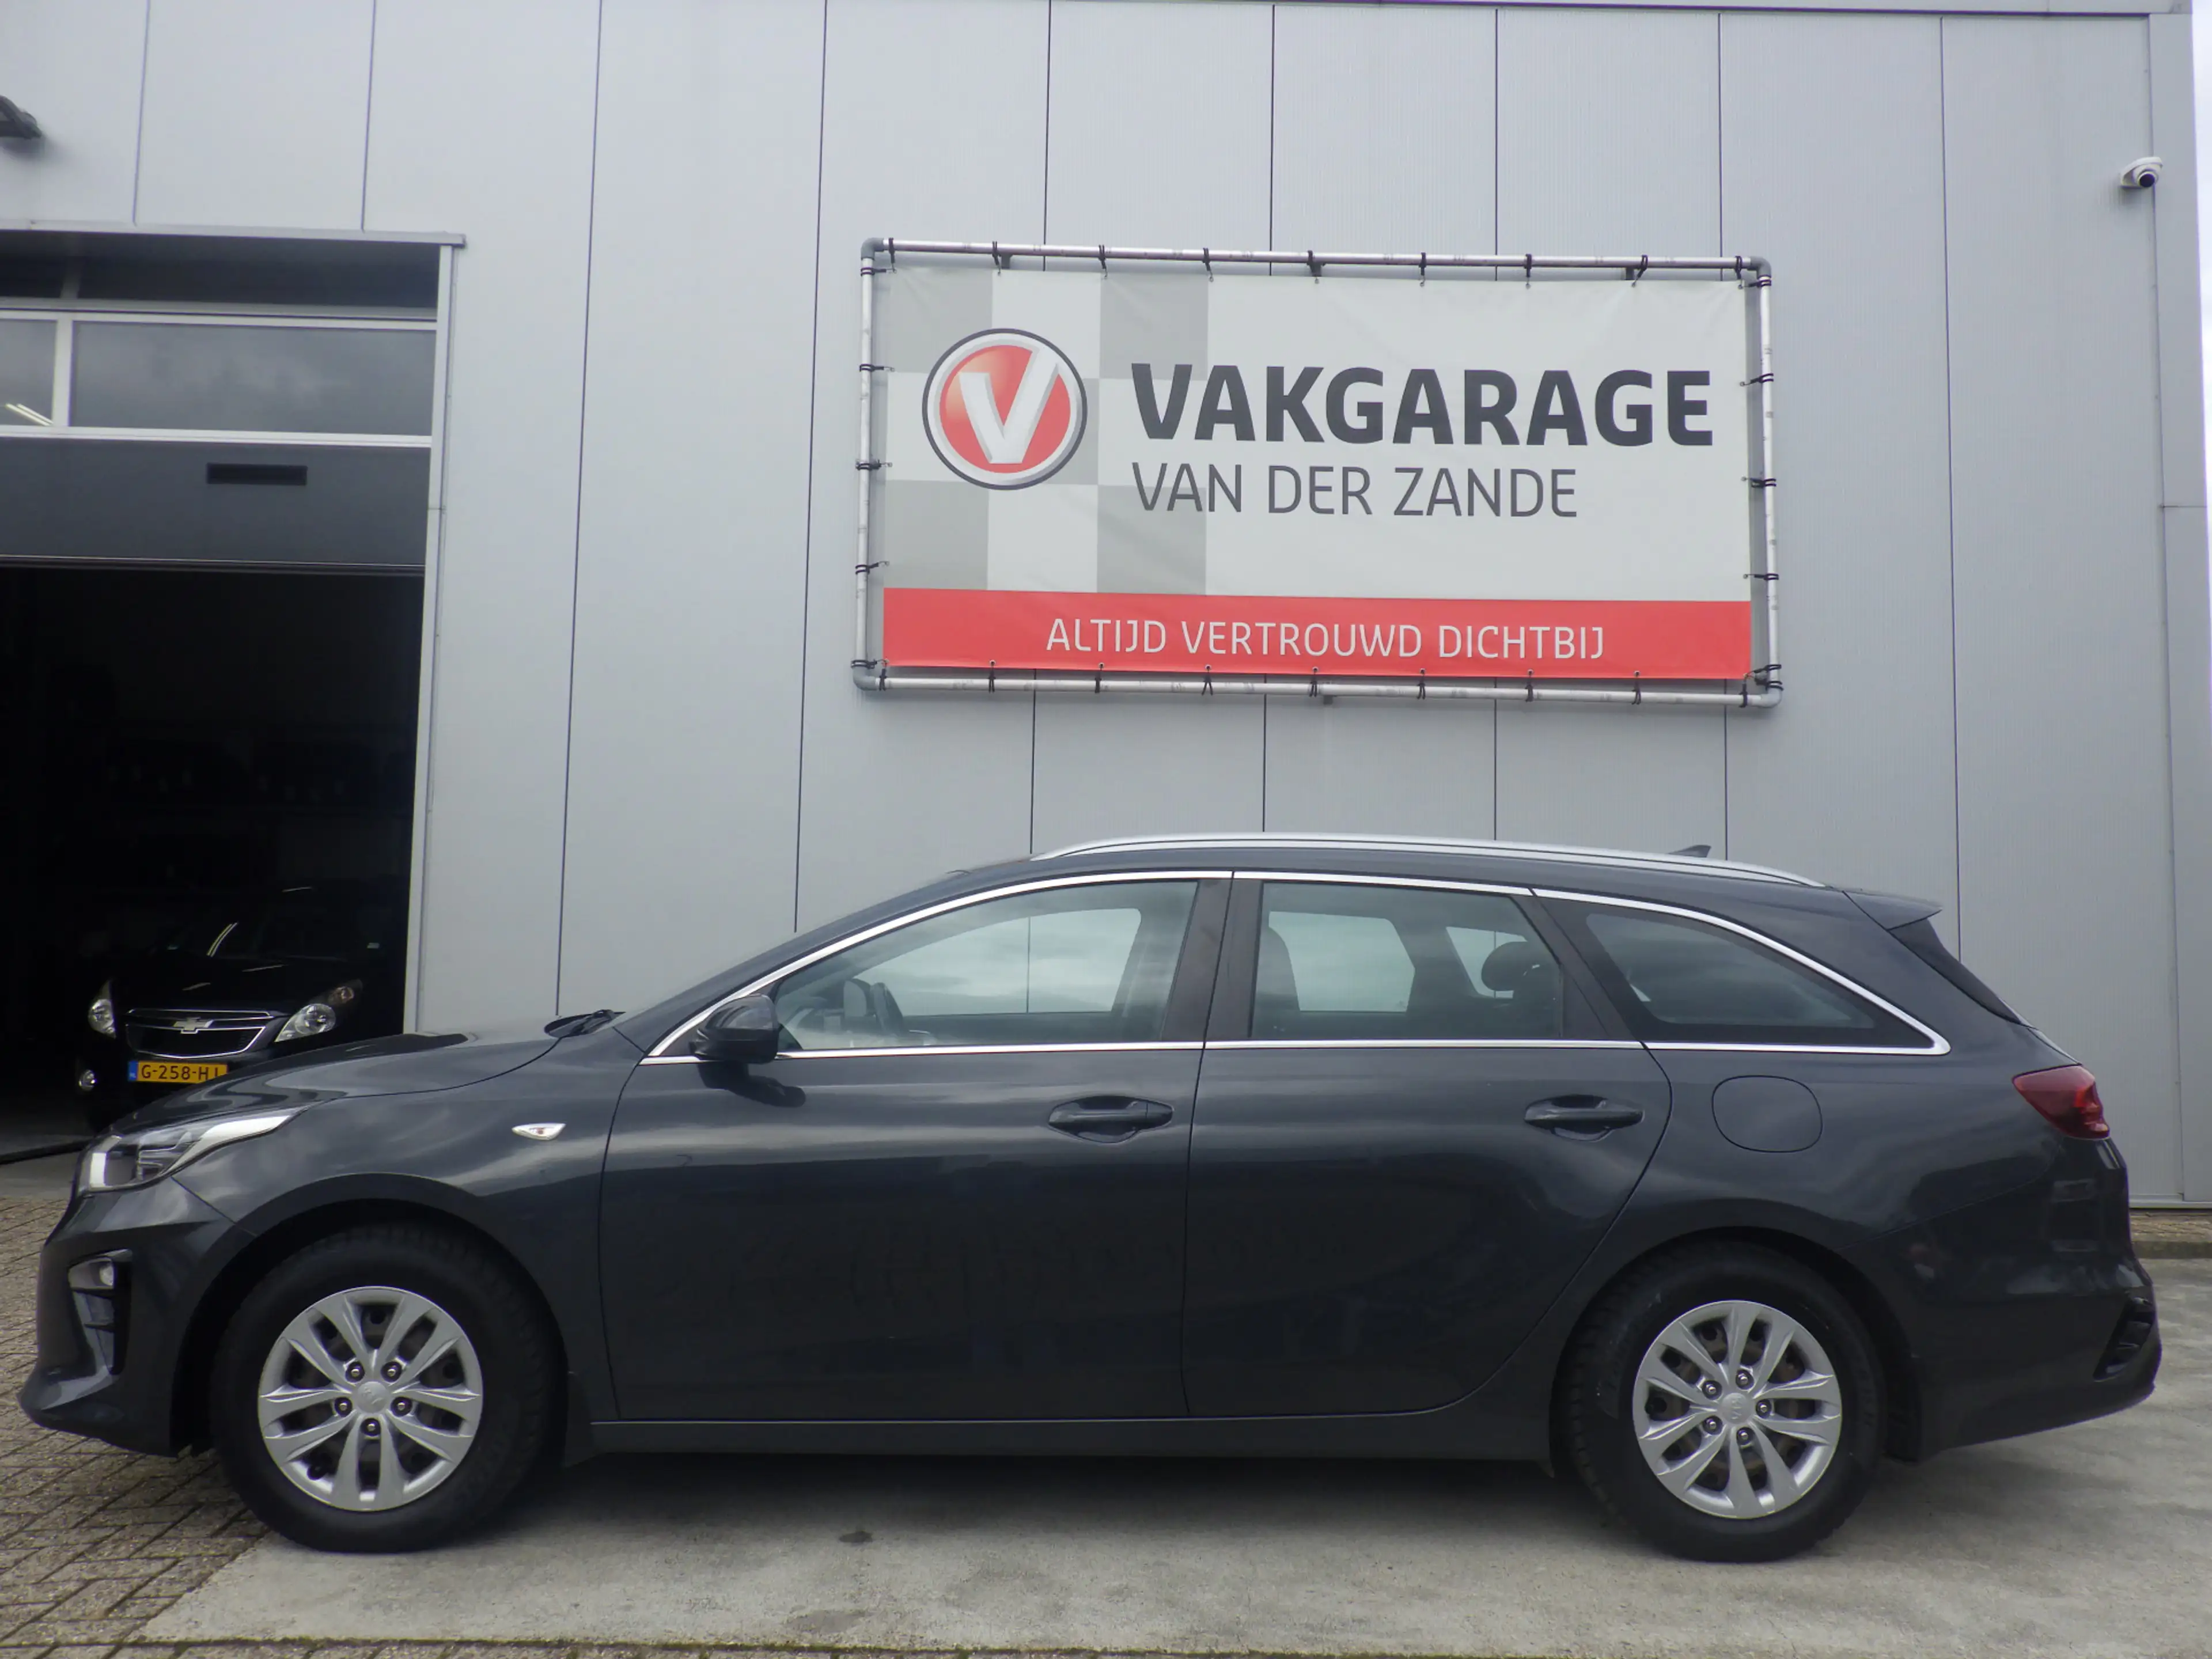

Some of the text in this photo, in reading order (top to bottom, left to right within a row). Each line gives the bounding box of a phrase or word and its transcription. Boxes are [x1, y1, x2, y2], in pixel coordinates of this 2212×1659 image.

[1131, 362, 1713, 448] VAKGARAGE
[1131, 461, 1578, 518] VAN DER ZANDE
[1046, 617, 1604, 660] ALTIJD VERTROUWD DICHTBIJ
